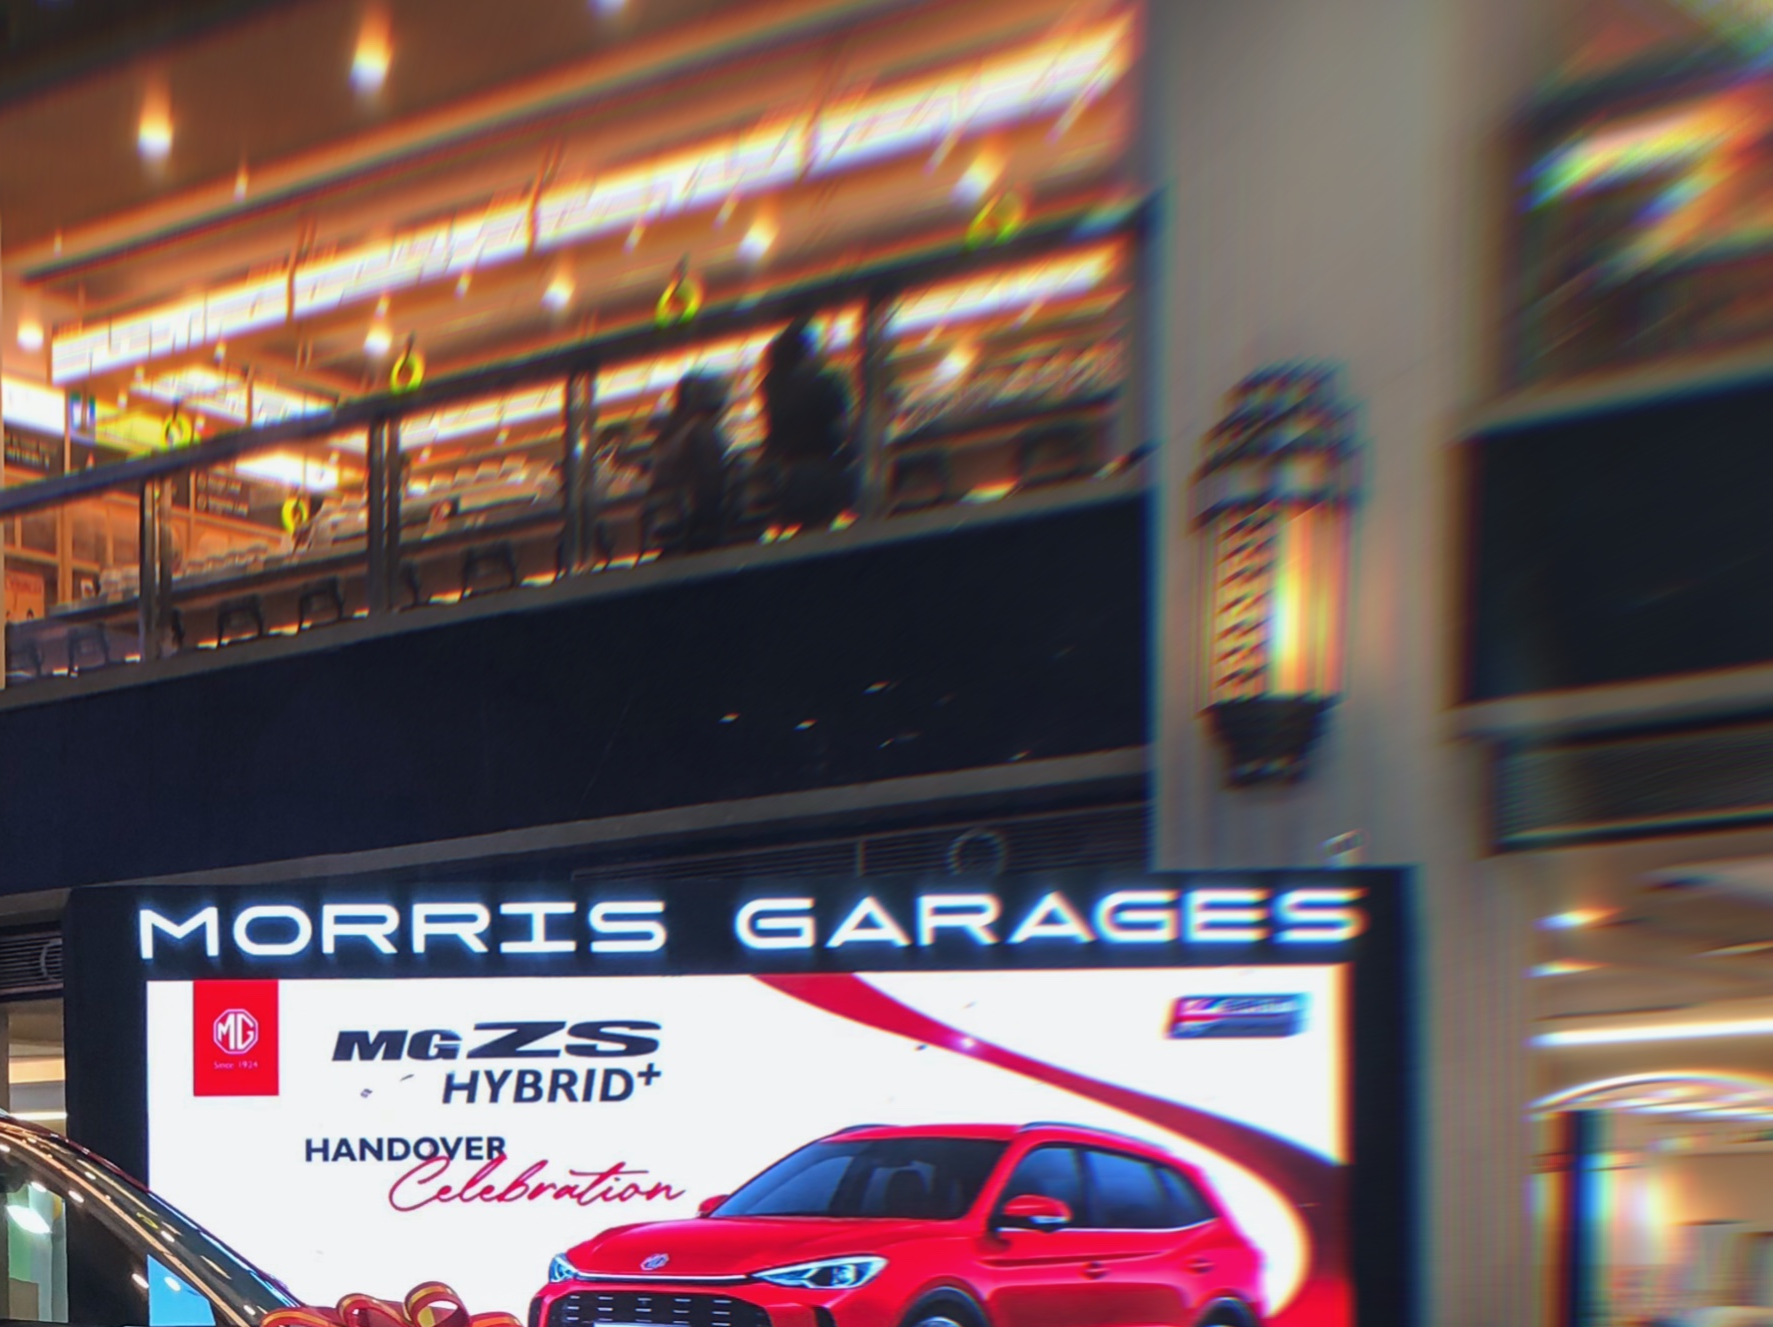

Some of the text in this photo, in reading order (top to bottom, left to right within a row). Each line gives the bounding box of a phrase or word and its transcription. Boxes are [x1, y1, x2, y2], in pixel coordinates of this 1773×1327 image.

[139, 889, 1369, 959] MORRIS GARAGES
[217, 1013, 254, 1050] MG
[238, 1060, 258, 1069] 1924
[442, 1063, 662, 1103] HYBRID+
[305, 1137, 508, 1162] HANDOVER
[388, 1153, 686, 1212] Celebration
